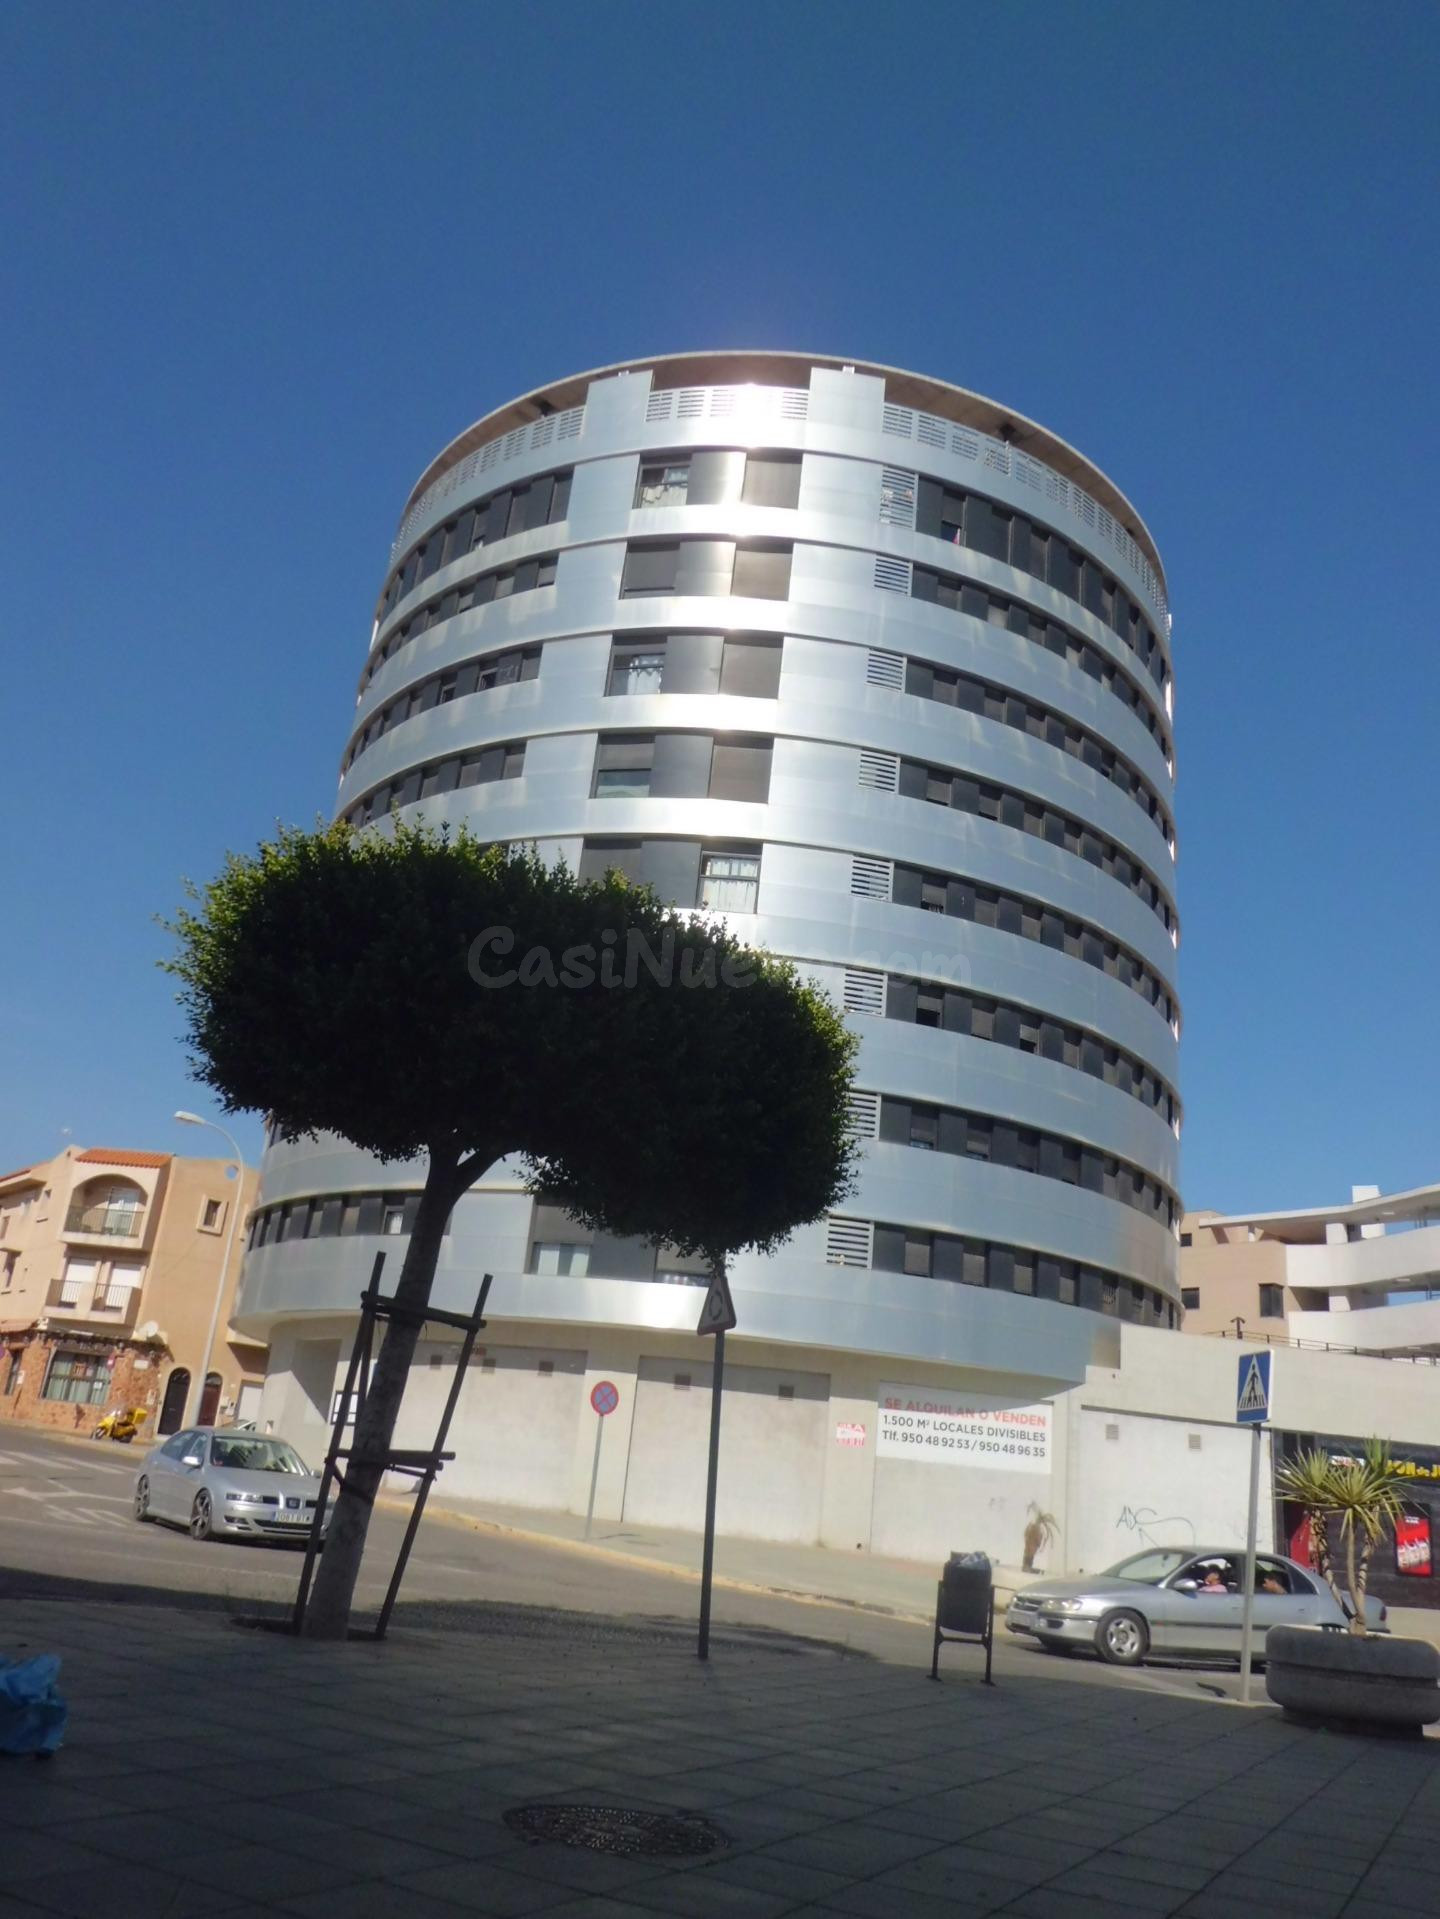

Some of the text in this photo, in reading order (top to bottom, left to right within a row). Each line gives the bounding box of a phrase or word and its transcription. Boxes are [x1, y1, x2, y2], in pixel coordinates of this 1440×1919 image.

[885, 1397, 1046, 1428] SE ALQUILAN O VENDEN
[884, 1415, 914, 1427] 1.500
[933, 1421, 984, 1436] LOCALES
[987, 1426, 1046, 1442] DIVISIBLES
[901, 1432, 923, 1444] 950
[925, 1435, 939, 1446] 48
[941, 1437, 955, 1448] 92
[957, 1439, 970, 1449] 53
[979, 1441, 1000, 1452] 950
[1002, 1444, 1016, 1454] 48
